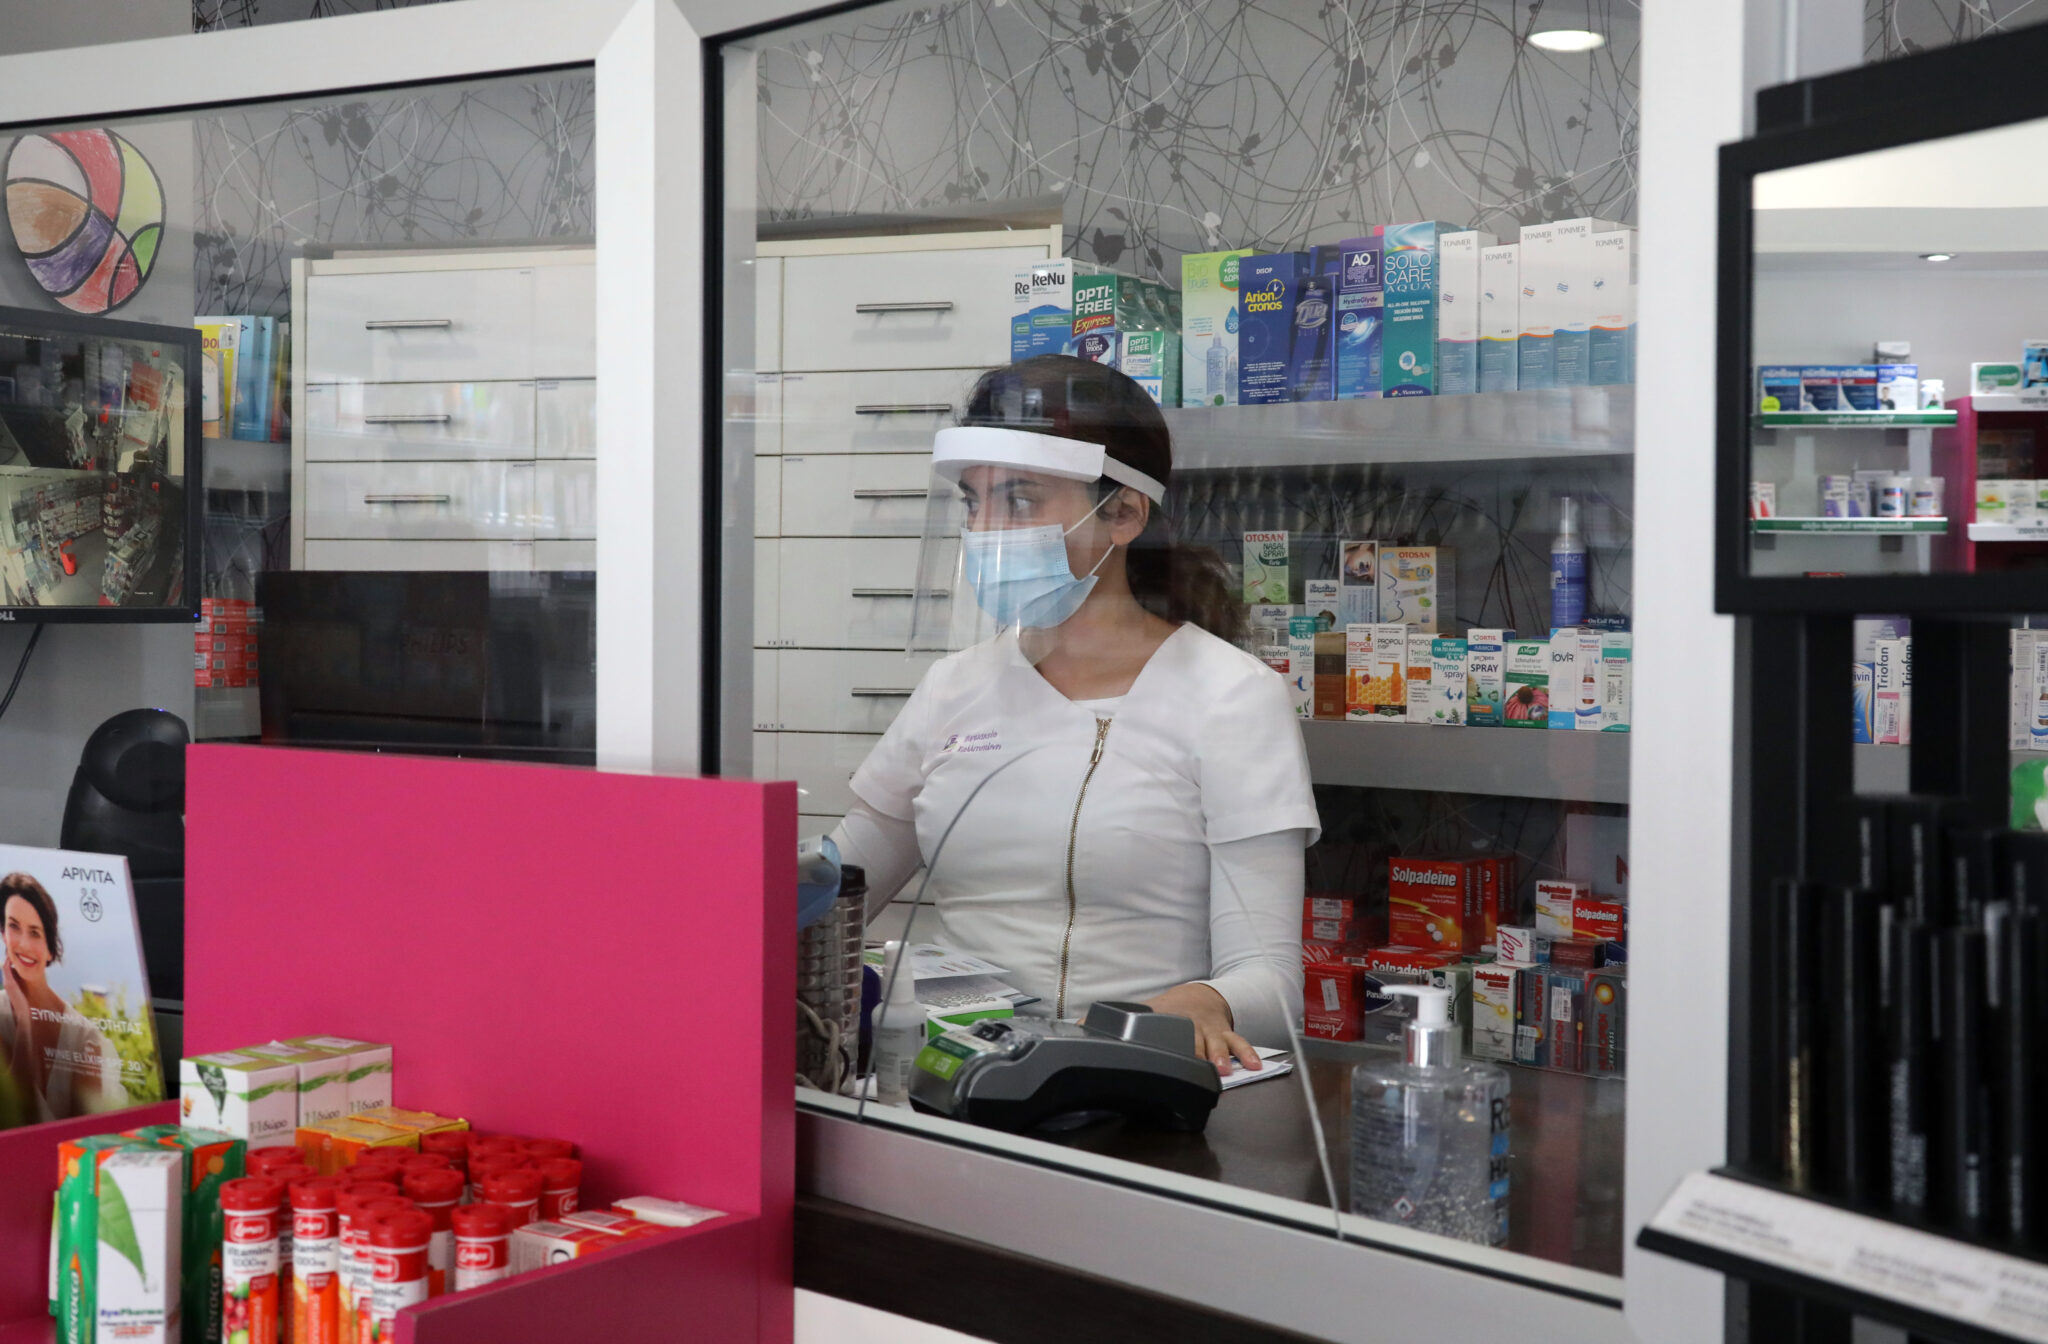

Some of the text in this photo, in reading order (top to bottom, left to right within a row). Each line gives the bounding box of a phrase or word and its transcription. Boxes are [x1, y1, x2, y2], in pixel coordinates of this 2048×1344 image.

[1351, 252, 1371, 267] AO
[1384, 252, 1432, 271] SOLO
[1032, 272, 1065, 287] ReNu
[1384, 266, 1432, 285] CARE
[1075, 285, 1113, 303] OPTI-
[1385, 281, 1432, 294] AQUA
[1244, 290, 1275, 304] Arion
[1075, 298, 1113, 316] FREE
[1247, 301, 1283, 312] cronos
[1074, 316, 1112, 334] Express
[1129, 344, 1150, 353] FREE
[1244, 532, 1286, 543] OTOSAN
[1398, 551, 1431, 559] OTOSAN
[1299, 650, 1313, 658] plus
[1411, 649, 1432, 657] THROA
[1432, 662, 1460, 672] Thymo
[1470, 663, 1499, 673] SPRAY
[1876, 646, 1889, 690] Triofan
[1901, 644, 1912, 688] Triofan
[1444, 671, 1465, 679] spray
[61, 867, 116, 885] APIVITA
[1392, 866, 1457, 887] Solpadeine
[1575, 907, 1619, 922] Solpadeine
[1366, 990, 1394, 1000] Panadol
[128, 1060, 142, 1072] 30
